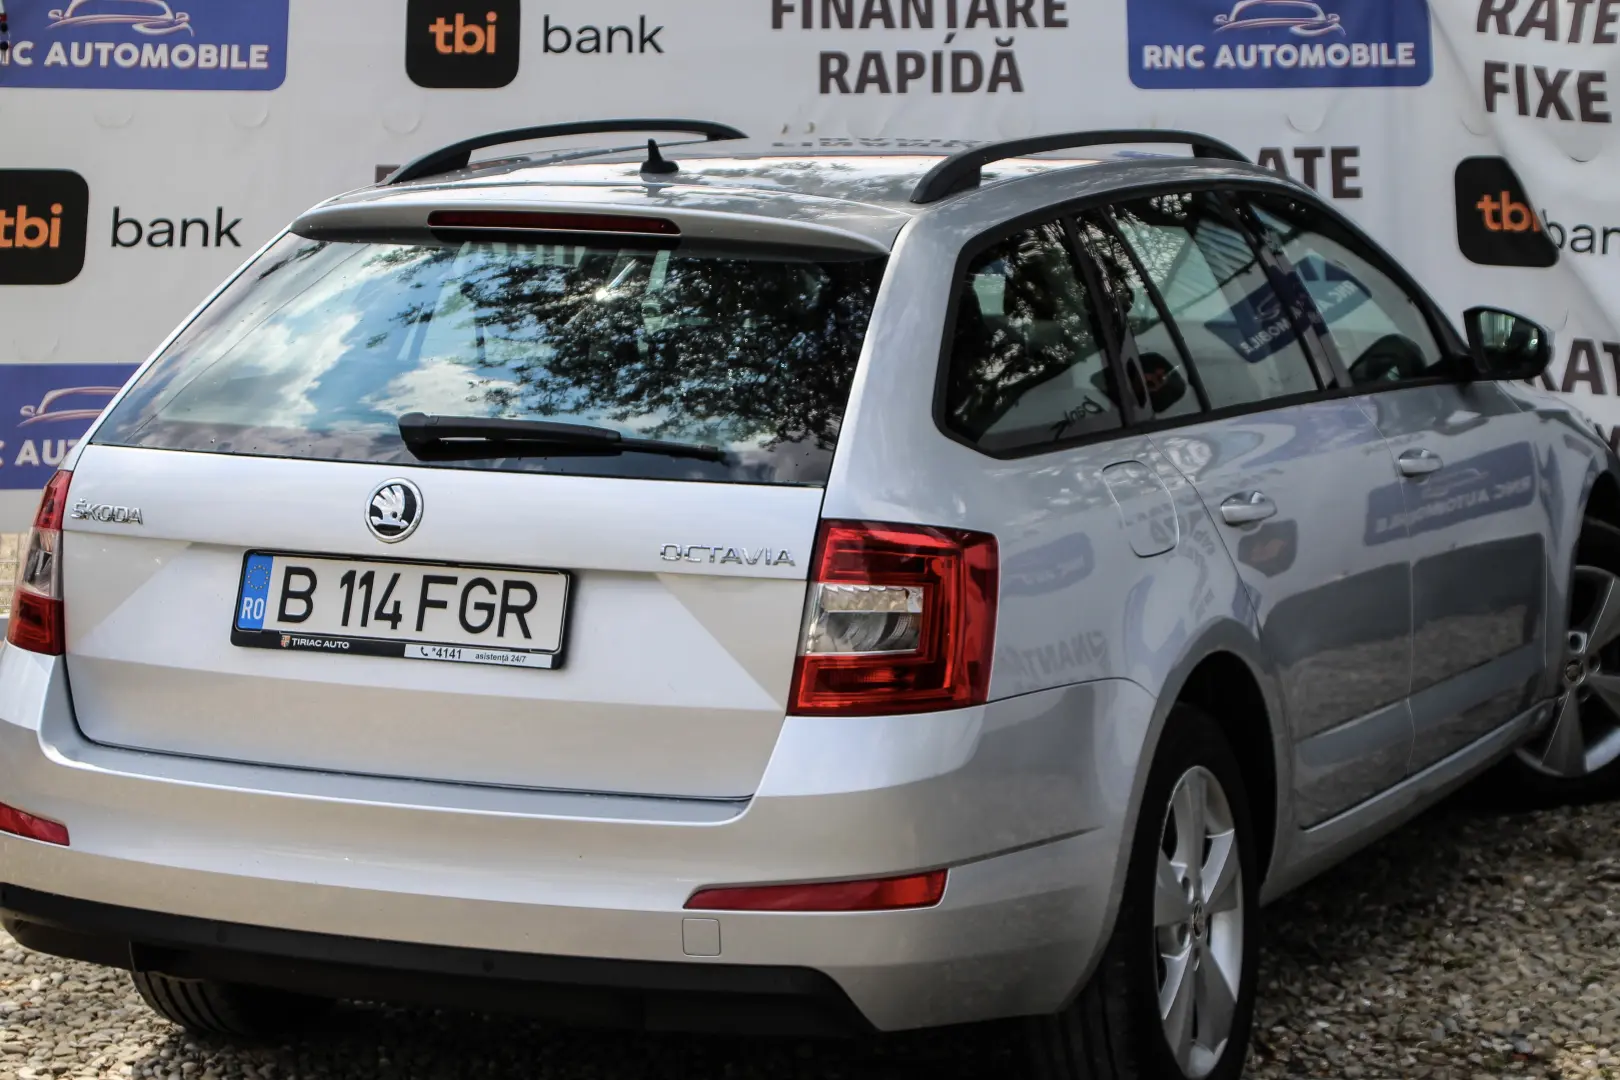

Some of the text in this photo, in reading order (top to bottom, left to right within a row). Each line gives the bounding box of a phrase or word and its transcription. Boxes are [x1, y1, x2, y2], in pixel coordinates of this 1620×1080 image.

[428, 11, 665, 55] tbi bank
[1476, 0, 1620, 44] RATE
[44, 41, 270, 70] AUTOMOBILE
[1142, 42, 1416, 69] RNC AUTOMOBILE
[1483, 59, 1613, 124] FIXE
[1256, 146, 1364, 200] ATE
[110, 206, 242, 248] bank
[1541, 208, 1620, 255] ban
[70, 497, 144, 525] ŠKODA
[659, 542, 796, 567] OCTAVIA
[240, 596, 265, 620] RO
[277, 565, 538, 640] B 114 FGR
[291, 637, 350, 650] TIRIAC AUTO
[510, 654, 526, 664] 24/7
